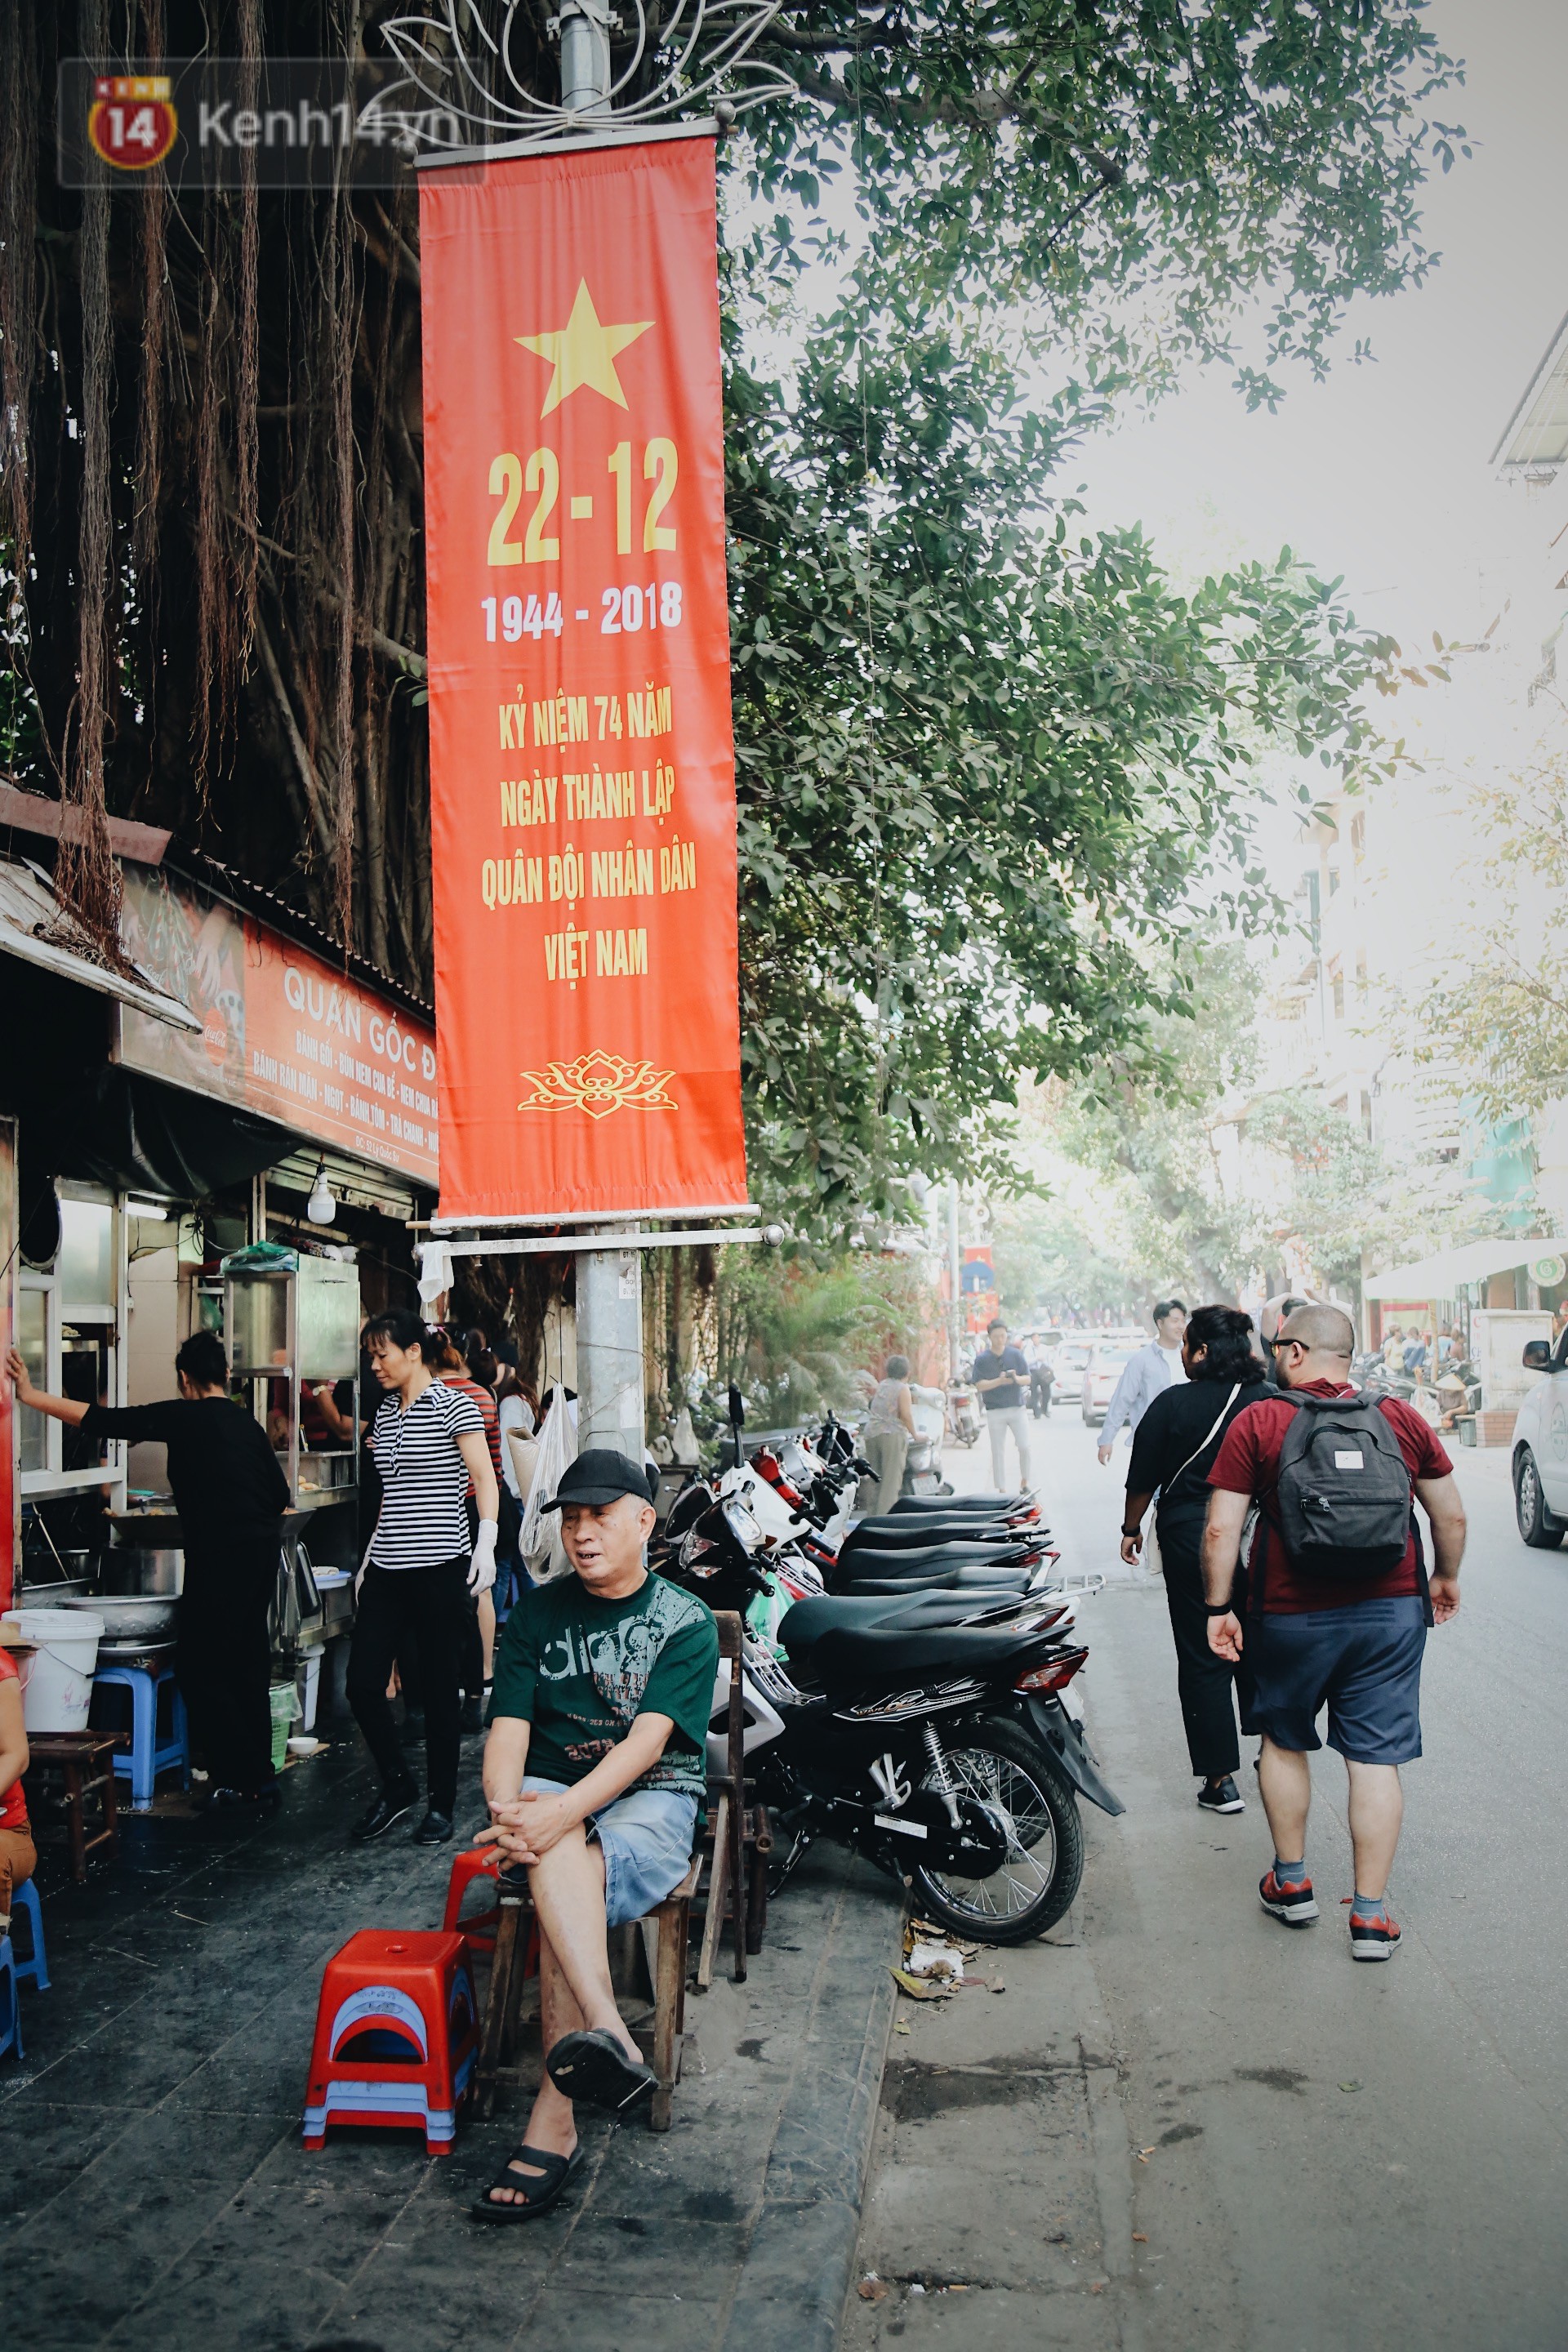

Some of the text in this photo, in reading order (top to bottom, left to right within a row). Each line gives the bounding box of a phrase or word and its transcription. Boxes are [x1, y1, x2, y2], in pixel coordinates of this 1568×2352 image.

[481, 592, 564, 642] 1944
[600, 581, 683, 634] 2018
[499, 682, 672, 753] KỶ NIỆM 74 NĂM
[501, 758, 675, 827] NGÀY THÀNH LẬP
[482, 834, 697, 911] QUÂN ĐỘI NHÂN DÂN
[544, 922, 648, 990] VIỆT NAM
[283, 966, 438, 1085] QUÁN GỐC Đ
[253, 1049, 278, 1084] BÁNH
[279, 1061, 297, 1093] RÁN
[324, 1084, 344, 1116] NGỌT
[350, 1094, 370, 1124] BÁNH
[403, 1120, 424, 1147] CHANH
[296, 1028, 318, 1062] BÁNH
[355, 1061, 372, 1089] NEM
[372, 1071, 385, 1096] CUA
[400, 1083, 415, 1109] NEM
[415, 1090, 430, 1116] CHUA
